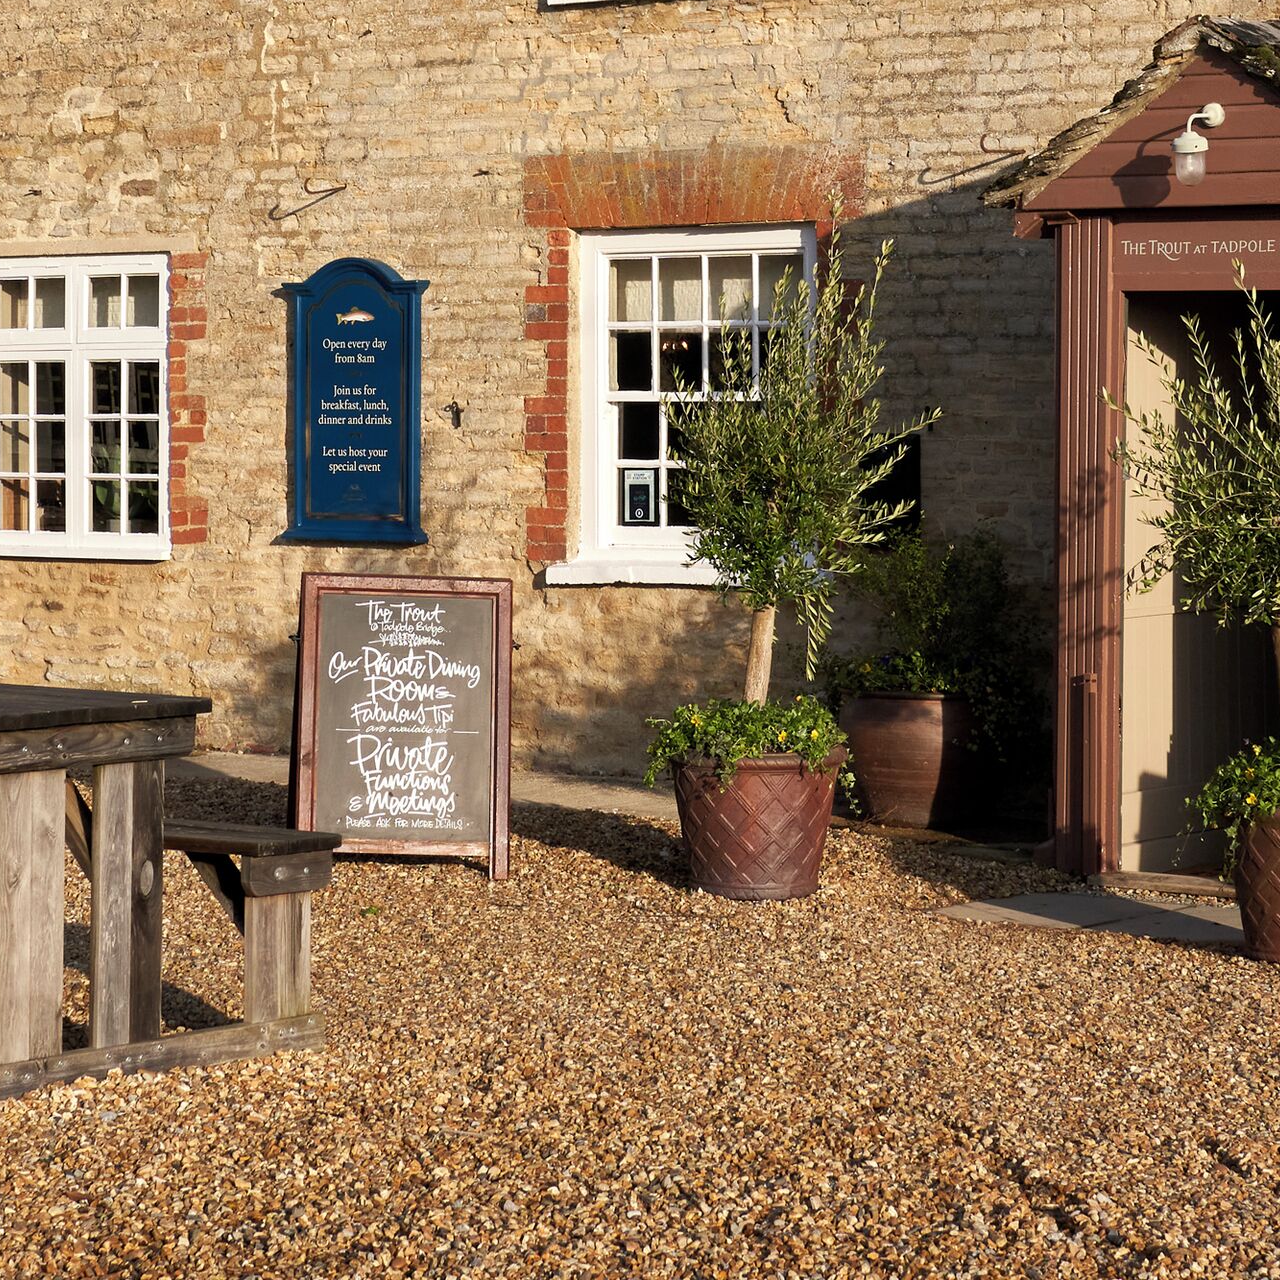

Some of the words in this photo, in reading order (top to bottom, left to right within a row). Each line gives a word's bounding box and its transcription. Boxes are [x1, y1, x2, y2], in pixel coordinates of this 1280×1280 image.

[1121, 240, 1146, 255] THE
[1147, 239, 1192, 261] TROUT
[1193, 244, 1207, 254] AT
[1211, 239, 1275, 253] TADPOLE
[322, 338, 346, 351] Open
[347, 340, 370, 351] every
[372, 338, 387, 350] day
[334, 353, 355, 363] from
[357, 353, 375, 363] 8am
[333, 385, 351, 397] Join
[352, 387, 362, 395] us
[363, 384, 377, 395] for
[321, 399, 362, 411] breakfast,
[363, 399, 389, 411] lunch,
[318, 414, 346, 425] dinner
[347, 414, 364, 425] and
[365, 414, 392, 425] drinks
[322, 446, 336, 457] Let
[337, 448, 347, 457] us
[349, 446, 366, 457] host
[367, 448, 388, 459] your
[328, 461, 357, 474] special
[358, 462, 381, 472] event
[355, 599, 393, 625] The
[390, 602, 446, 624] Trout
[328, 651, 363, 679] Our
[361, 646, 426, 679] Private
[425, 650, 481, 688] Dining
[351, 701, 426, 726] Fabulous
[424, 704, 454, 728] Tipi
[365, 725, 386, 733] are
[435, 726, 452, 734] for
[347, 734, 454, 776] Private
[364, 770, 451, 797] Functions
[348, 796, 362, 812] &
[366, 789, 456, 819] Meetings
[376, 817, 392, 828] ASK
